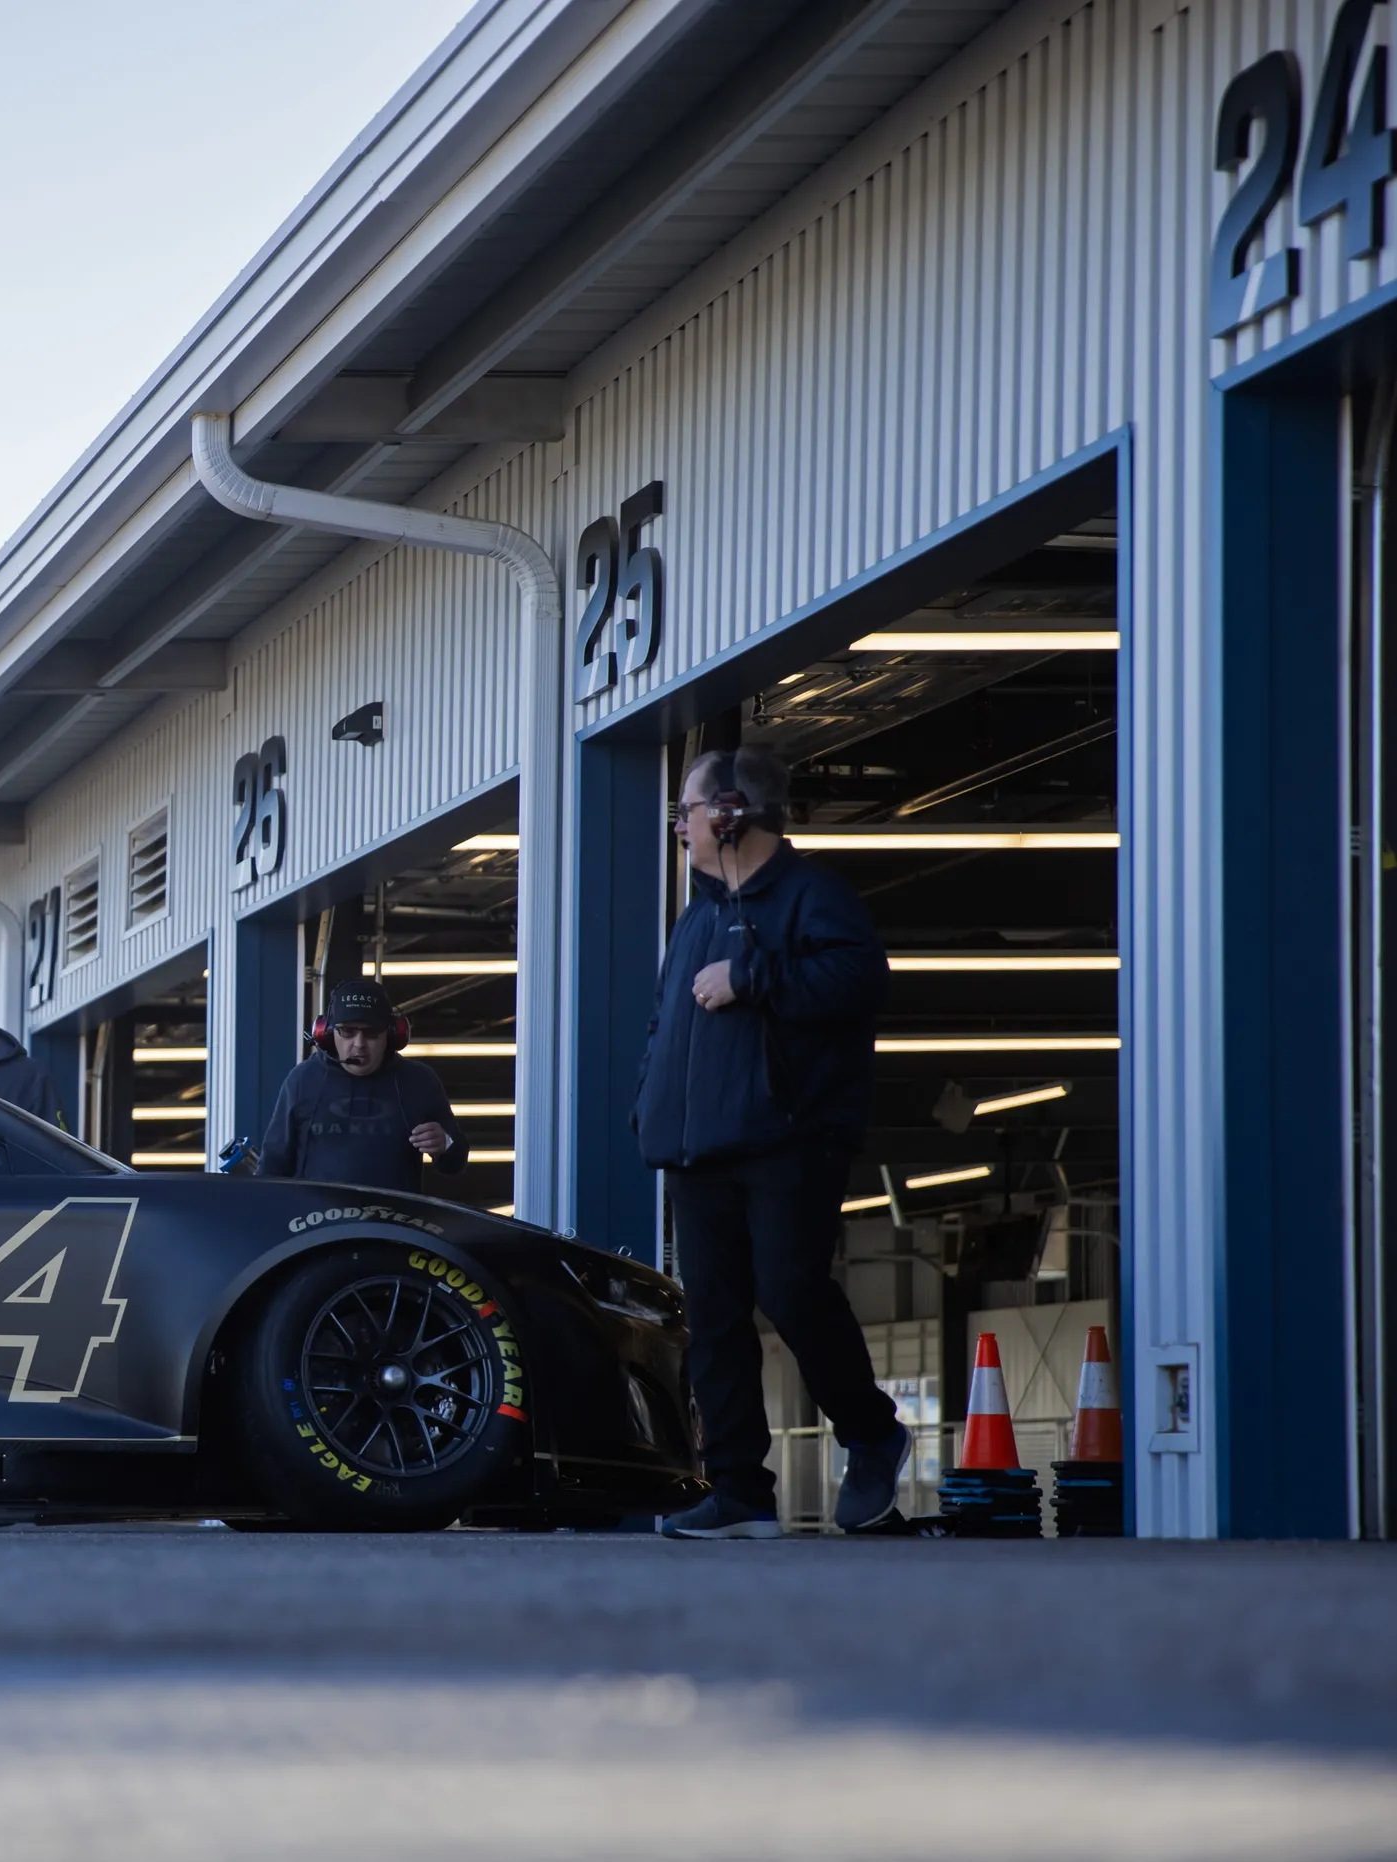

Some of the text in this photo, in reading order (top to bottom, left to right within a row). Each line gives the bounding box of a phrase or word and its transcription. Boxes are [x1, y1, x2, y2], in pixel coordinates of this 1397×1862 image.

[1210, 0, 1397, 340] 24
[574, 480, 664, 706] 25
[232, 735, 287, 893] 26
[26, 886, 62, 1013] 27
[341, 994, 378, 1004] LEGACY
[288, 1205, 445, 1236] GOODYEAR
[295, 1421, 373, 1493] EAGLE
